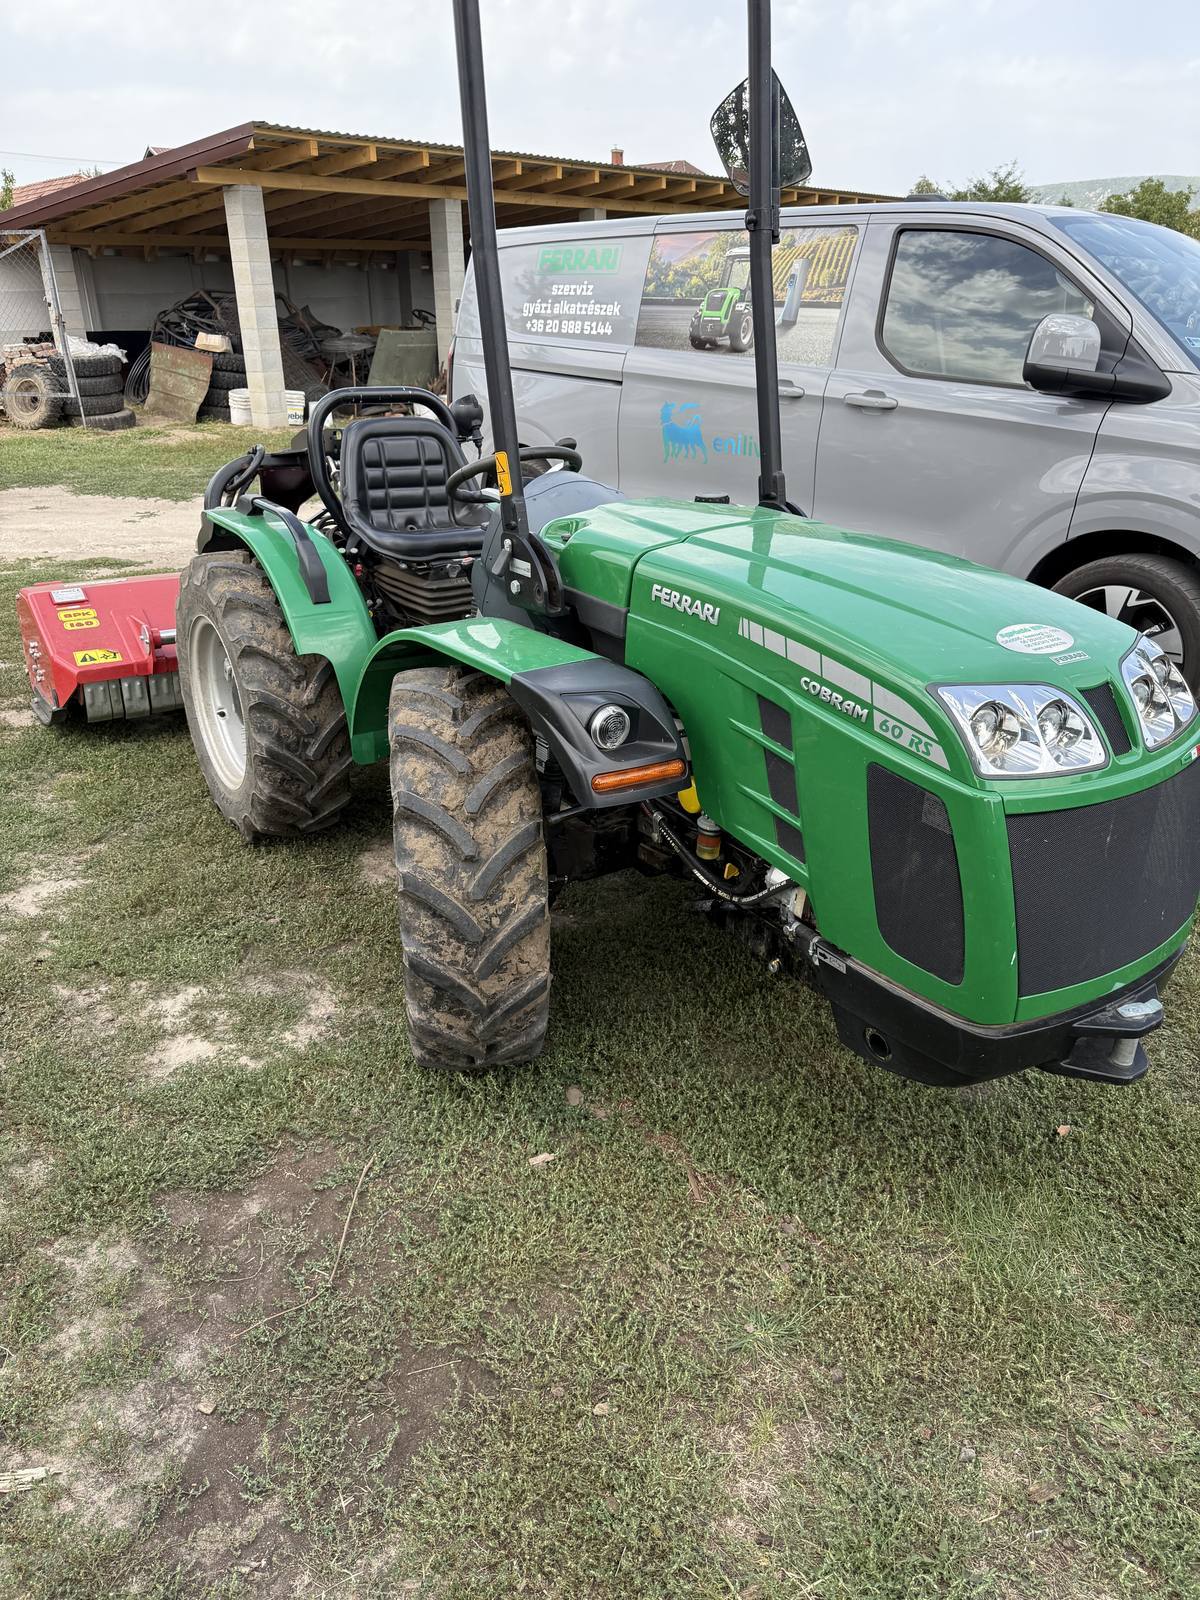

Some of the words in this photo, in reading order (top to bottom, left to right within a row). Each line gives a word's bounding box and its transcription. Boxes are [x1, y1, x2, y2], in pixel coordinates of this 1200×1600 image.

[540, 248, 618, 271] FERRARI
[551, 280, 594, 296] szerviz
[522, 298, 552, 317] gyári
[553, 299, 621, 316] alkatrészek
[526, 319, 544, 332] +36
[545, 319, 559, 333] 20
[561, 320, 581, 334] 988
[583, 321, 612, 335] 5144
[288, 412, 304, 420] ebe
[712, 432, 760, 458] eniliv
[651, 584, 720, 626] FERRARI
[800, 676, 869, 723] COBRAM
[879, 718, 904, 740] 60
[909, 733, 934, 758] RS
